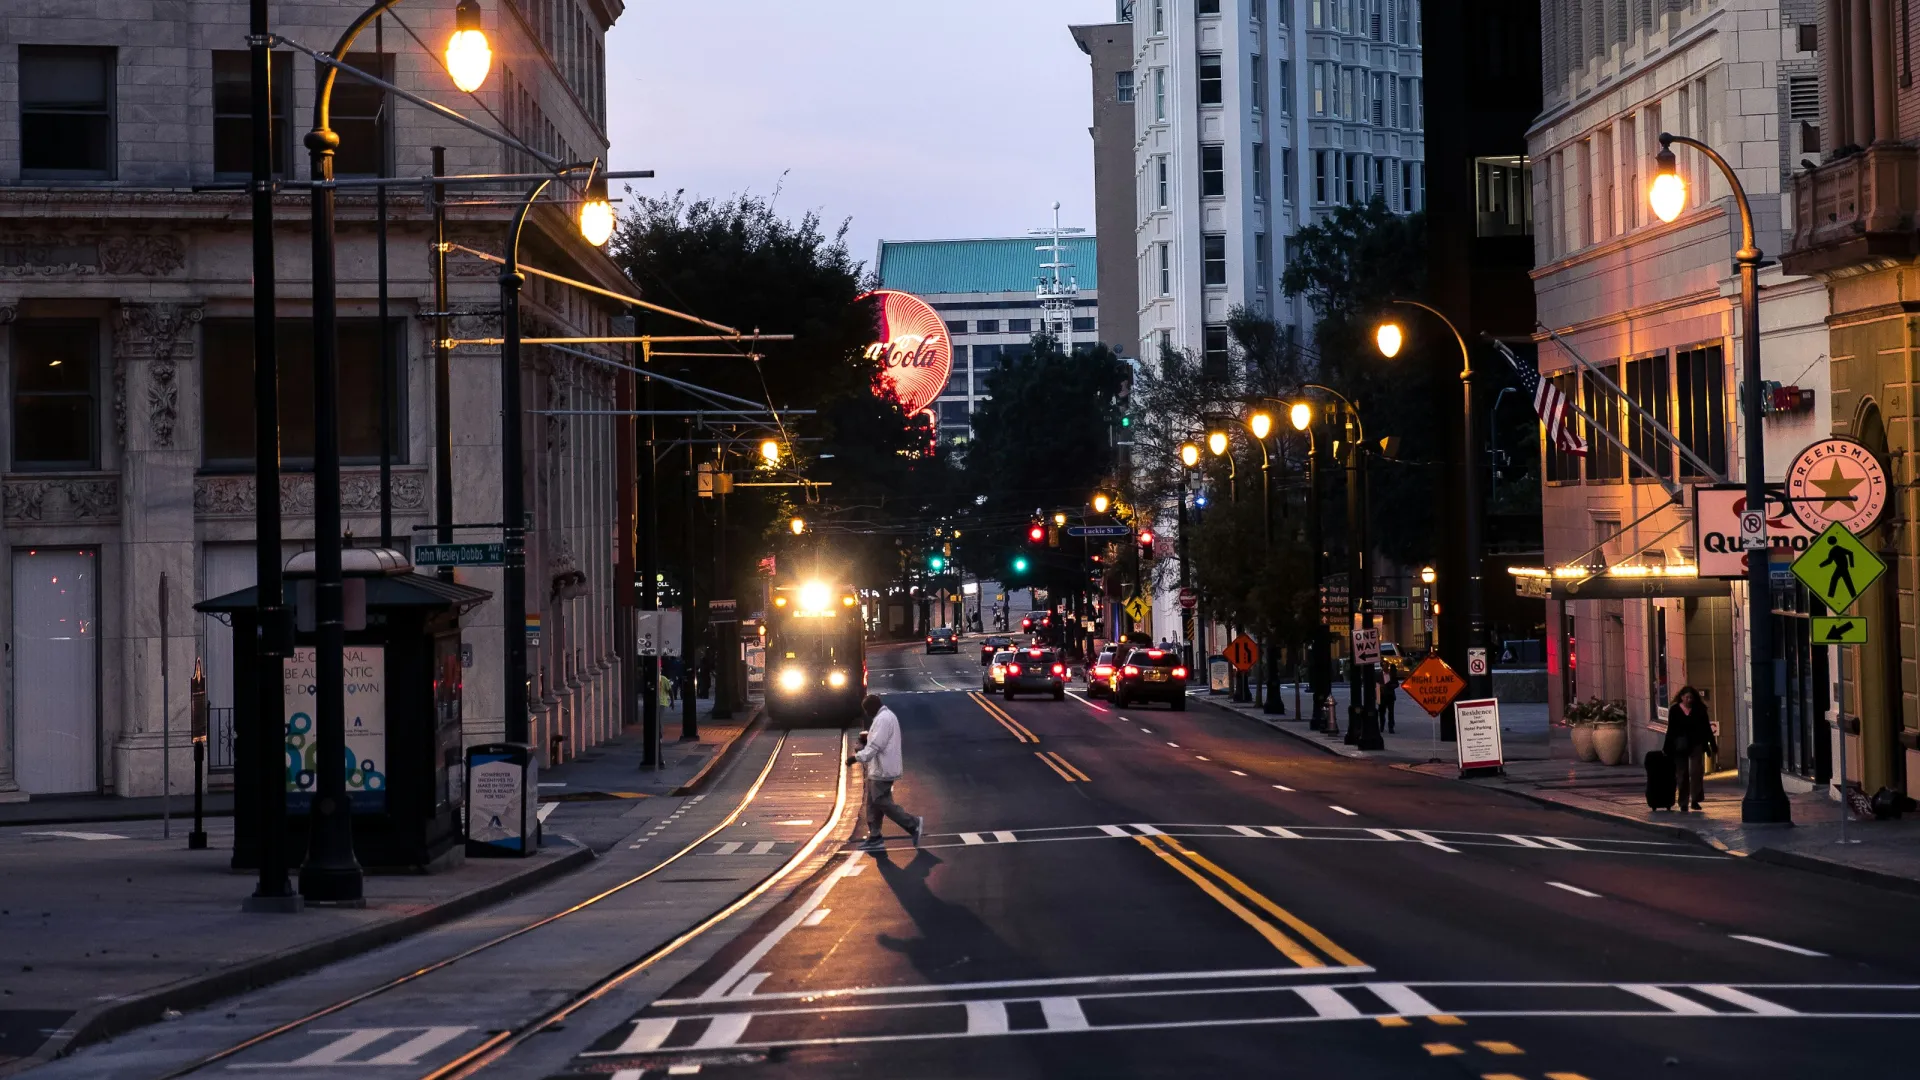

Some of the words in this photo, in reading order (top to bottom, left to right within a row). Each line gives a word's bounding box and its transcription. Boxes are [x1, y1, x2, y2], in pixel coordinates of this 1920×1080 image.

[1794, 444, 1882, 488] BREENSMITH
[1799, 503, 1878, 530] ADVEISING
[488, 544, 501, 552] AVE
[1704, 531, 1818, 555] Quno
[416, 548, 435, 563] John
[435, 547, 460, 564] Wesley
[461, 546, 483, 561] Dobbs
[490, 553, 500, 561] NE
[1642, 582, 1665, 594] 134
[1329, 596, 1349, 605] Underg
[1355, 630, 1376, 642] ONE
[1356, 641, 1377, 652] WAY
[291, 652, 304, 663] BE
[308, 652, 367, 663] ONAL
[285, 668, 299, 679] BE
[301, 667, 373, 679] AUNTIC
[1411, 676, 1433, 685] RIGHT
[1436, 675, 1455, 684] LANE
[1419, 686, 1448, 695] CLOSED
[1423, 696, 1447, 705] AHEAD
[1461, 709, 1492, 717] Residence
